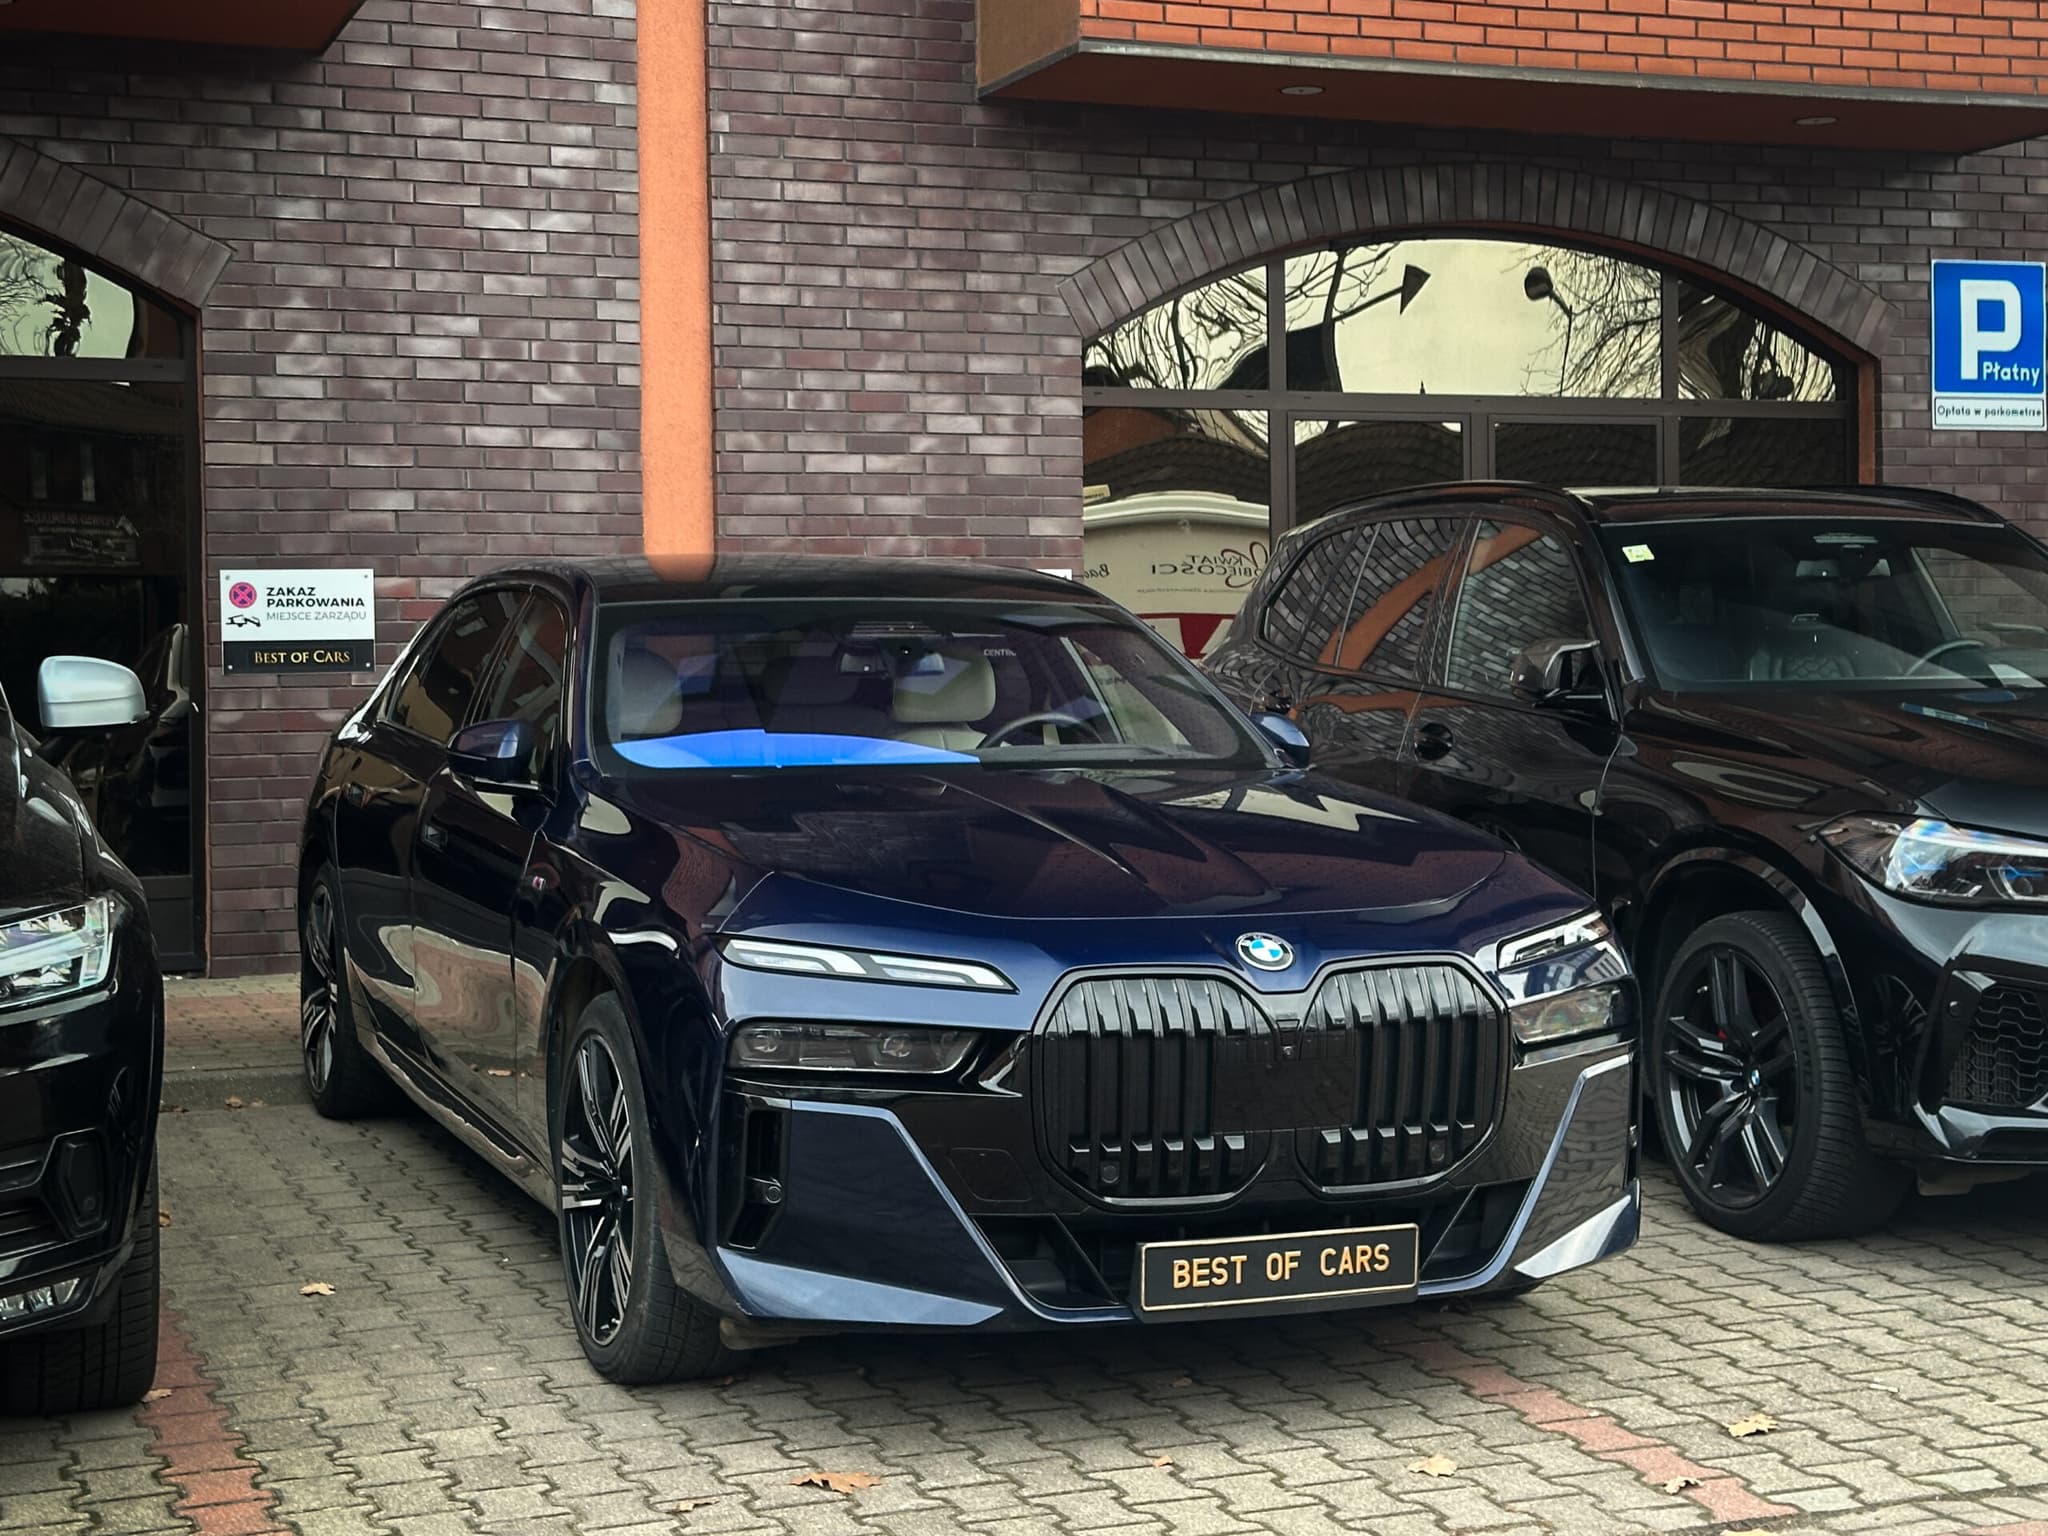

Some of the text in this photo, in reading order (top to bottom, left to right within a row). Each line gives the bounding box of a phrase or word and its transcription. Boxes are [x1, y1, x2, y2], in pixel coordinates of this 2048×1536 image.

[1960, 279, 2022, 380] P
[1982, 361, 2040, 387] Płatny
[1937, 404, 1971, 418] Opłata
[1974, 407, 1981, 416] w
[266, 587, 316, 597] ZAKAZ
[266, 597, 365, 608] PARKOWANIA
[266, 611, 367, 622] MIEJSCE ZARZĄDU
[290, 651, 310, 664] OF
[1172, 1243, 1391, 1289] BEST OF CARS
